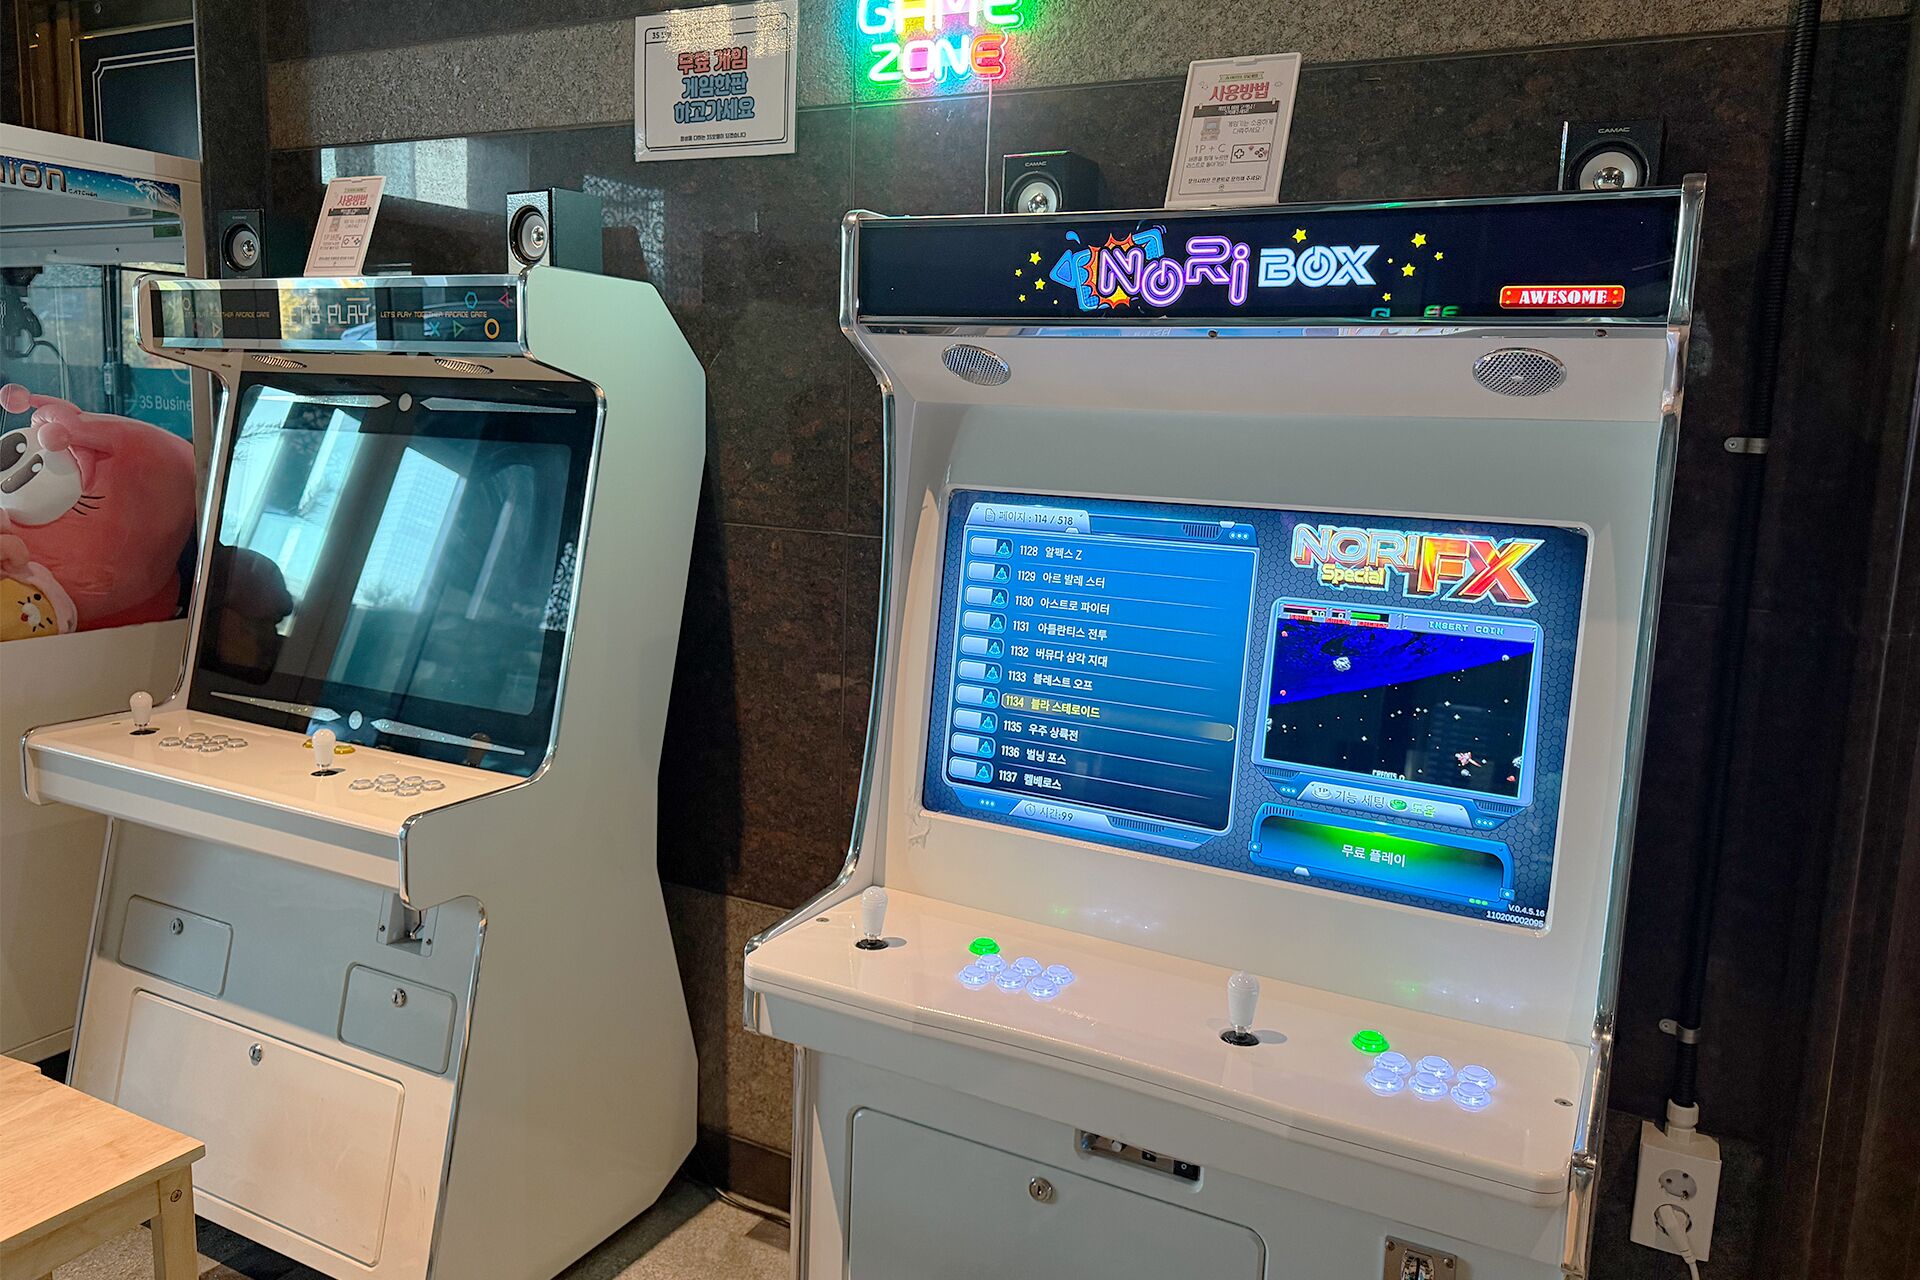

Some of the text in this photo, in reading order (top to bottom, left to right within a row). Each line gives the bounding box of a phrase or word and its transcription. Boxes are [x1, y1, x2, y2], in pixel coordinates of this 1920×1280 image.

[857, 0, 1019, 34] GAME
[677, 46, 748, 75] 무료 게임
[869, 34, 1002, 81] ZONE
[681, 71, 748, 99] 게임한판
[1209, 81, 1270, 101] 사용방법
[673, 96, 755, 124] 하고가세요
[1195, 144, 1206, 153] 1P
[1218, 143, 1227, 152] C
[0, 160, 66, 192] ion
[1258, 244, 1381, 288] BOX
[1519, 289, 1609, 305] AWESOME
[327, 304, 371, 325] PLAY
[139, 394, 154, 410] 3S
[998, 511, 1026, 523] 페이지
[1034, 514, 1047, 523] 114
[1057, 515, 1074, 526] 518
[1020, 545, 1038, 556] 1128
[1075, 549, 1083, 560] Z
[1292, 525, 1544, 604] NORI FX
[1321, 563, 1385, 586] Special
[1017, 570, 1105, 589] 1129 아르 발레 스터
[1015, 595, 1110, 615] 1130 아스트로 파이터
[1013, 620, 1108, 641] 1131 아틀란티스 전투
[1429, 621, 1505, 635] INSERT COIN
[1010, 645, 1108, 668] 1132 버뮤다 삼각 지대
[1008, 670, 1027, 682] 1133
[1073, 679, 1093, 691] 오프
[1005, 695, 1025, 708] 1134
[1051, 702, 1100, 718] 스테로이드
[1003, 720, 1079, 742] 1135 우주 상륙전
[1001, 745, 1020, 758] 1136
[1047, 752, 1067, 765] 포스
[998, 769, 1018, 782] 1137
[1335, 790, 1437, 818] 기능 세팅 도움
[1341, 844, 1406, 868] 무료 플레이
[1486, 910, 1544, 928] 110200002095
[1508, 903, 1545, 917] V.0.4.5.16
